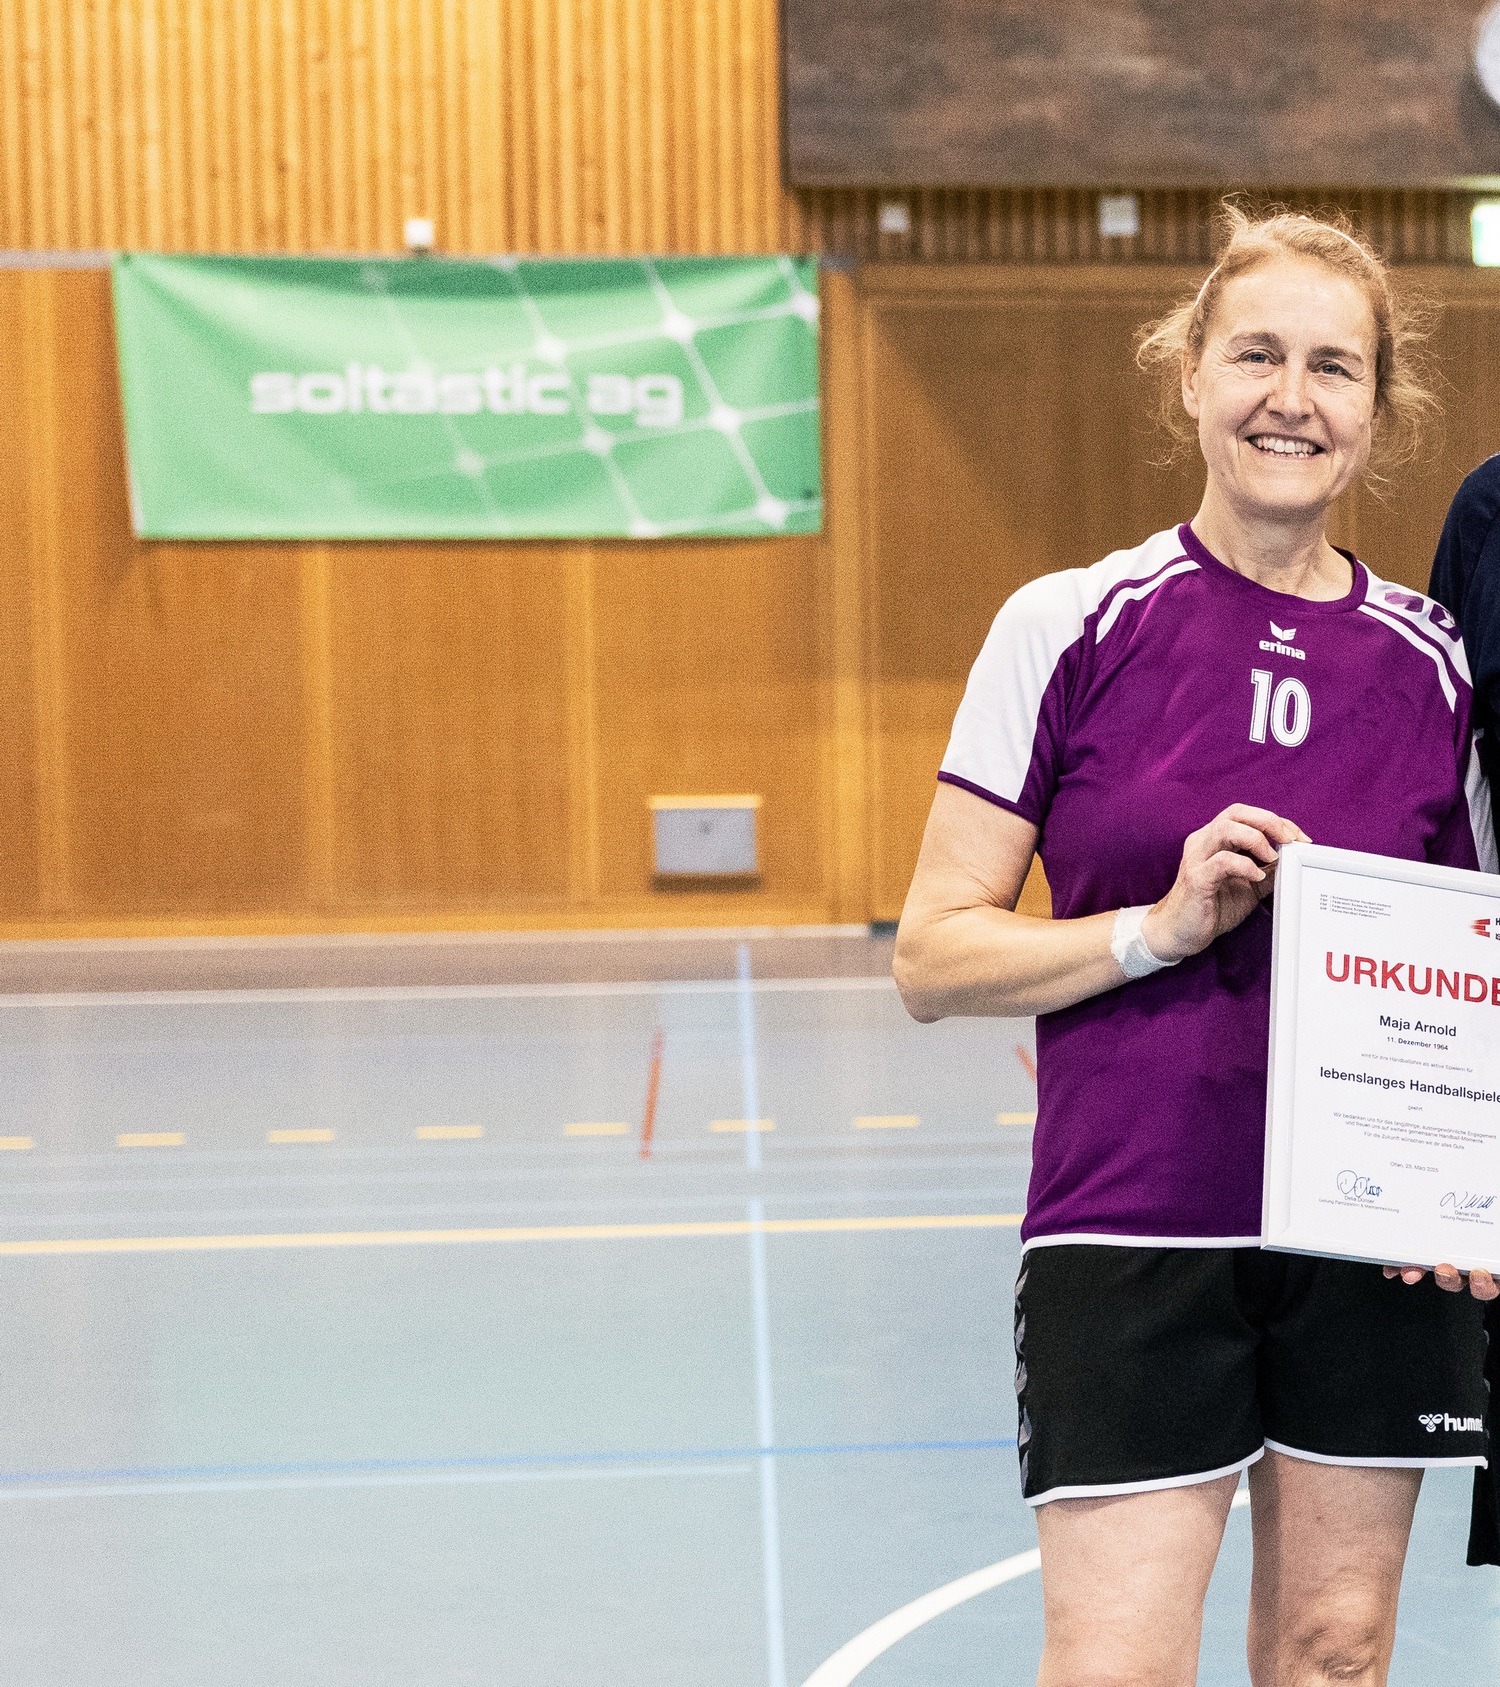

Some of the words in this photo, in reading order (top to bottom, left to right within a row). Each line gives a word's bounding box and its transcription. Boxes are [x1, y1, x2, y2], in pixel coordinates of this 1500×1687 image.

[250, 363, 570, 414] soltastic
[587, 374, 684, 427] ag
[1258, 639, 1306, 661] erima
[1249, 668, 1312, 748] 10
[1379, 1015, 1411, 1031] Maja
[1414, 1020, 1457, 1037] Arnold
[1397, 1037, 1432, 1049] Dezember
[1433, 1043, 1449, 1051] 1964
[1320, 1066, 1406, 1090] lebenslanges
[1444, 1412, 1483, 1432] humm
